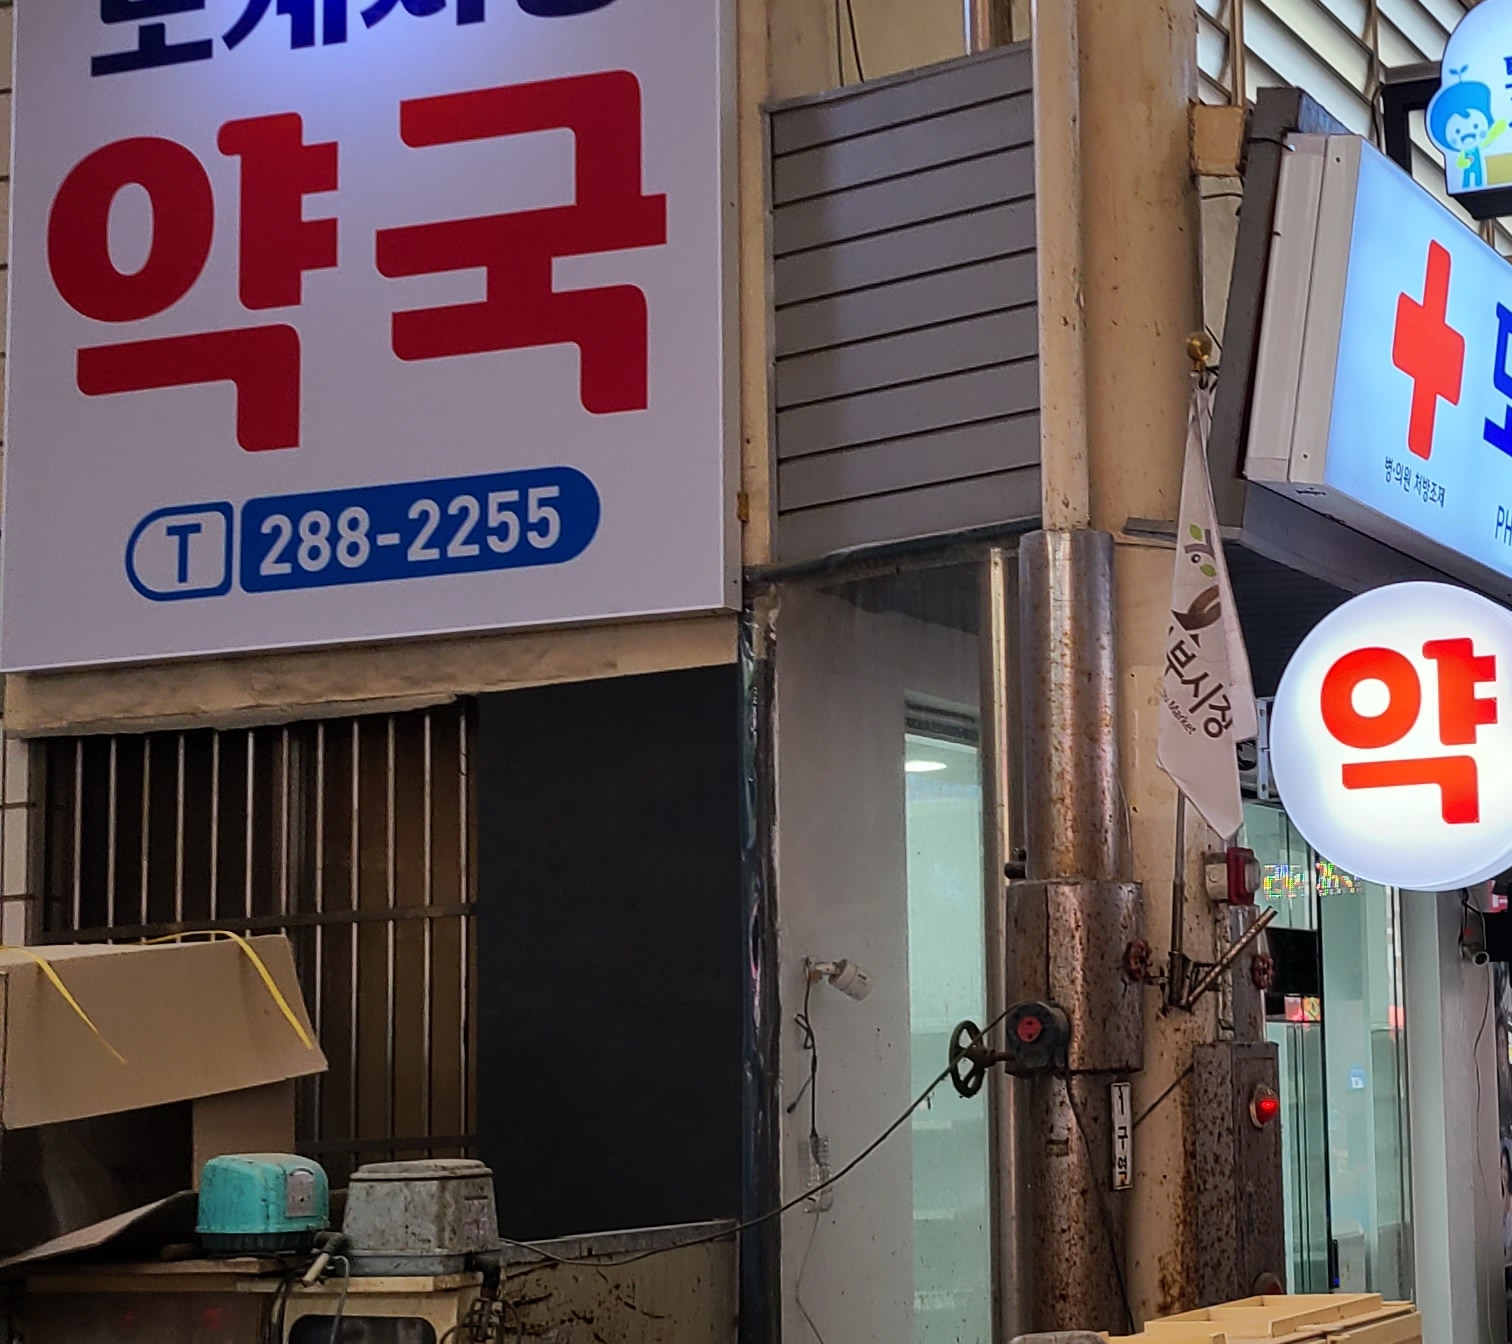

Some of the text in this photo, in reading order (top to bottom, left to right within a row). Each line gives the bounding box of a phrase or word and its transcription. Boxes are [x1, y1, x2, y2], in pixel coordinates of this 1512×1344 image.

[46, 69, 668, 453] 약국
[166, 485, 562, 584] T 288-2255
[1413, 473, 1446, 508] 처방조제
[1165, 624, 1233, 739] 부시장
[1320, 637, 1497, 824] 약
